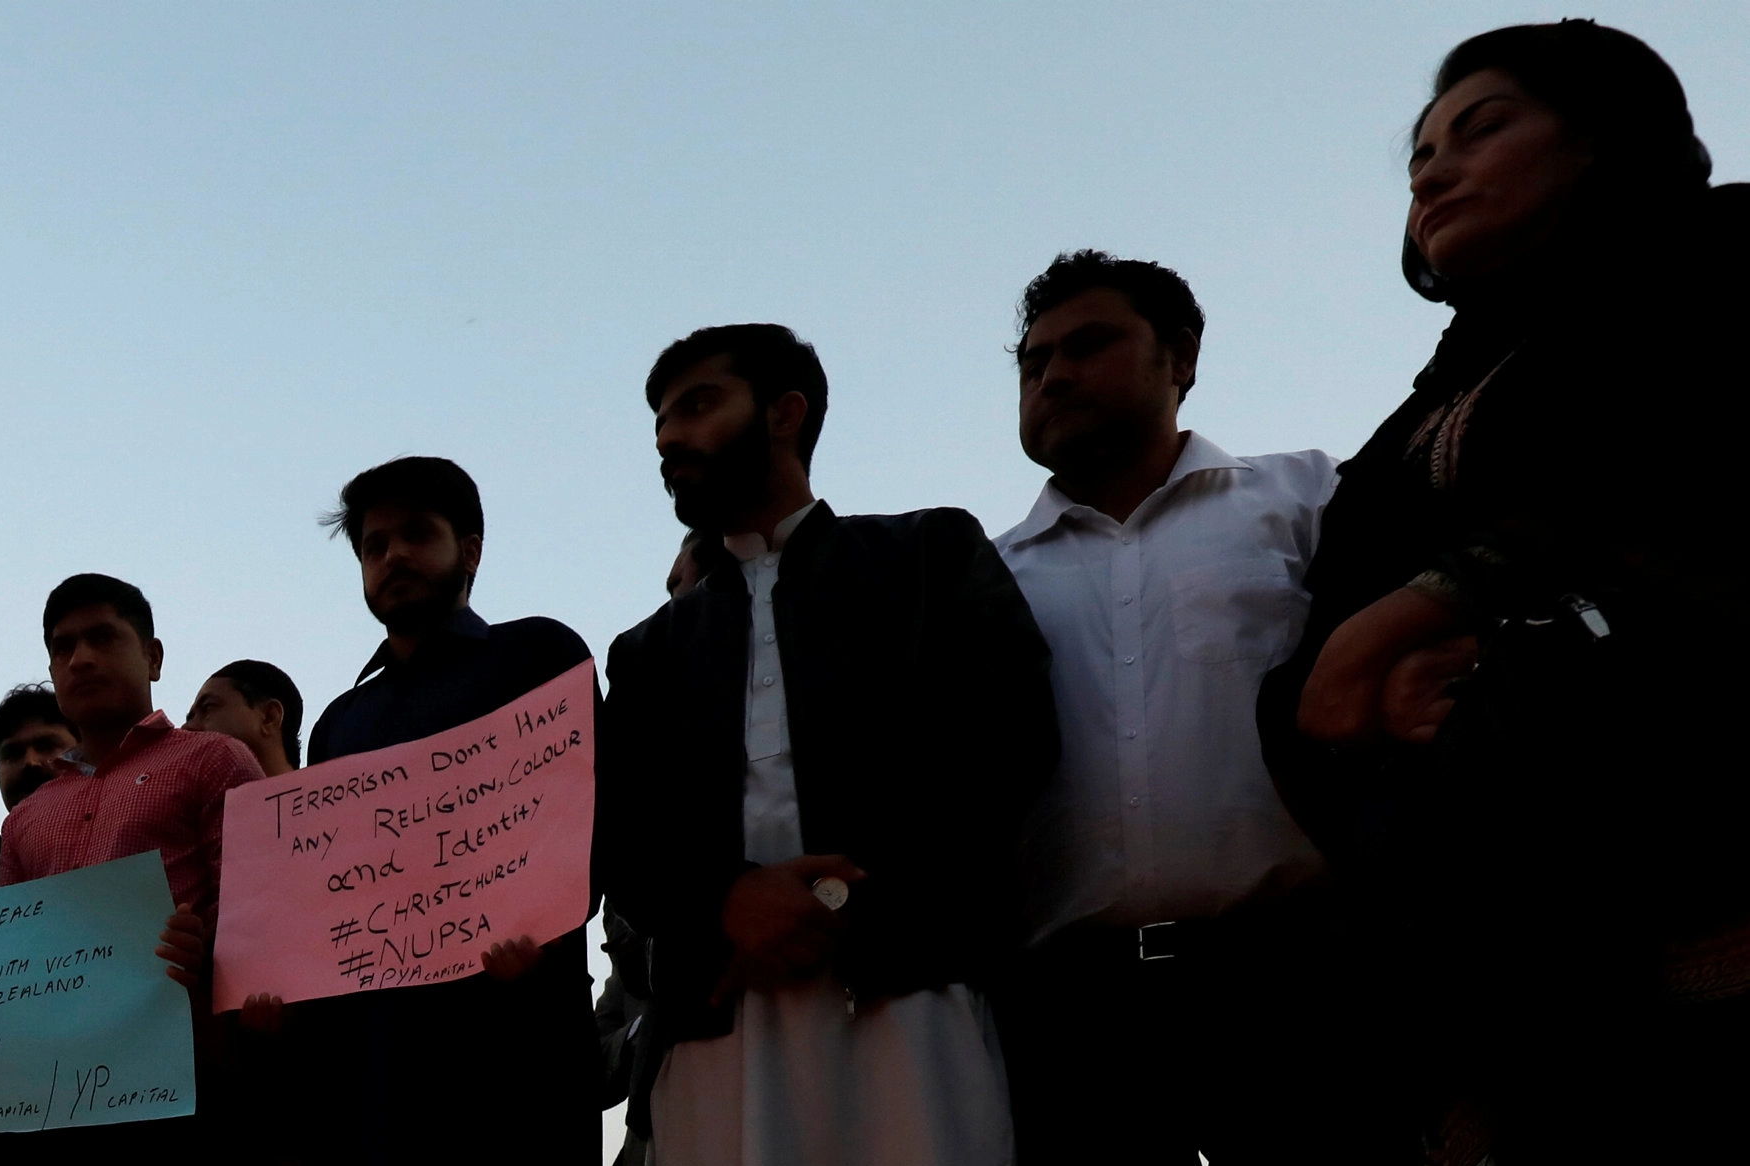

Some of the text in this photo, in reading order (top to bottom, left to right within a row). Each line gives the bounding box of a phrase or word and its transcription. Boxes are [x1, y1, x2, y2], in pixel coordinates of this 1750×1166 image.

[515, 698, 569, 737] HAVE
[291, 827, 339, 861] ANY
[327, 849, 404, 892] and
[330, 851, 528, 949] #CHRISTCHURCH
[46, 946, 113, 974] VICTIMS
[338, 913, 491, 977] #NUPSA
[70, 1064, 110, 1120] YP
